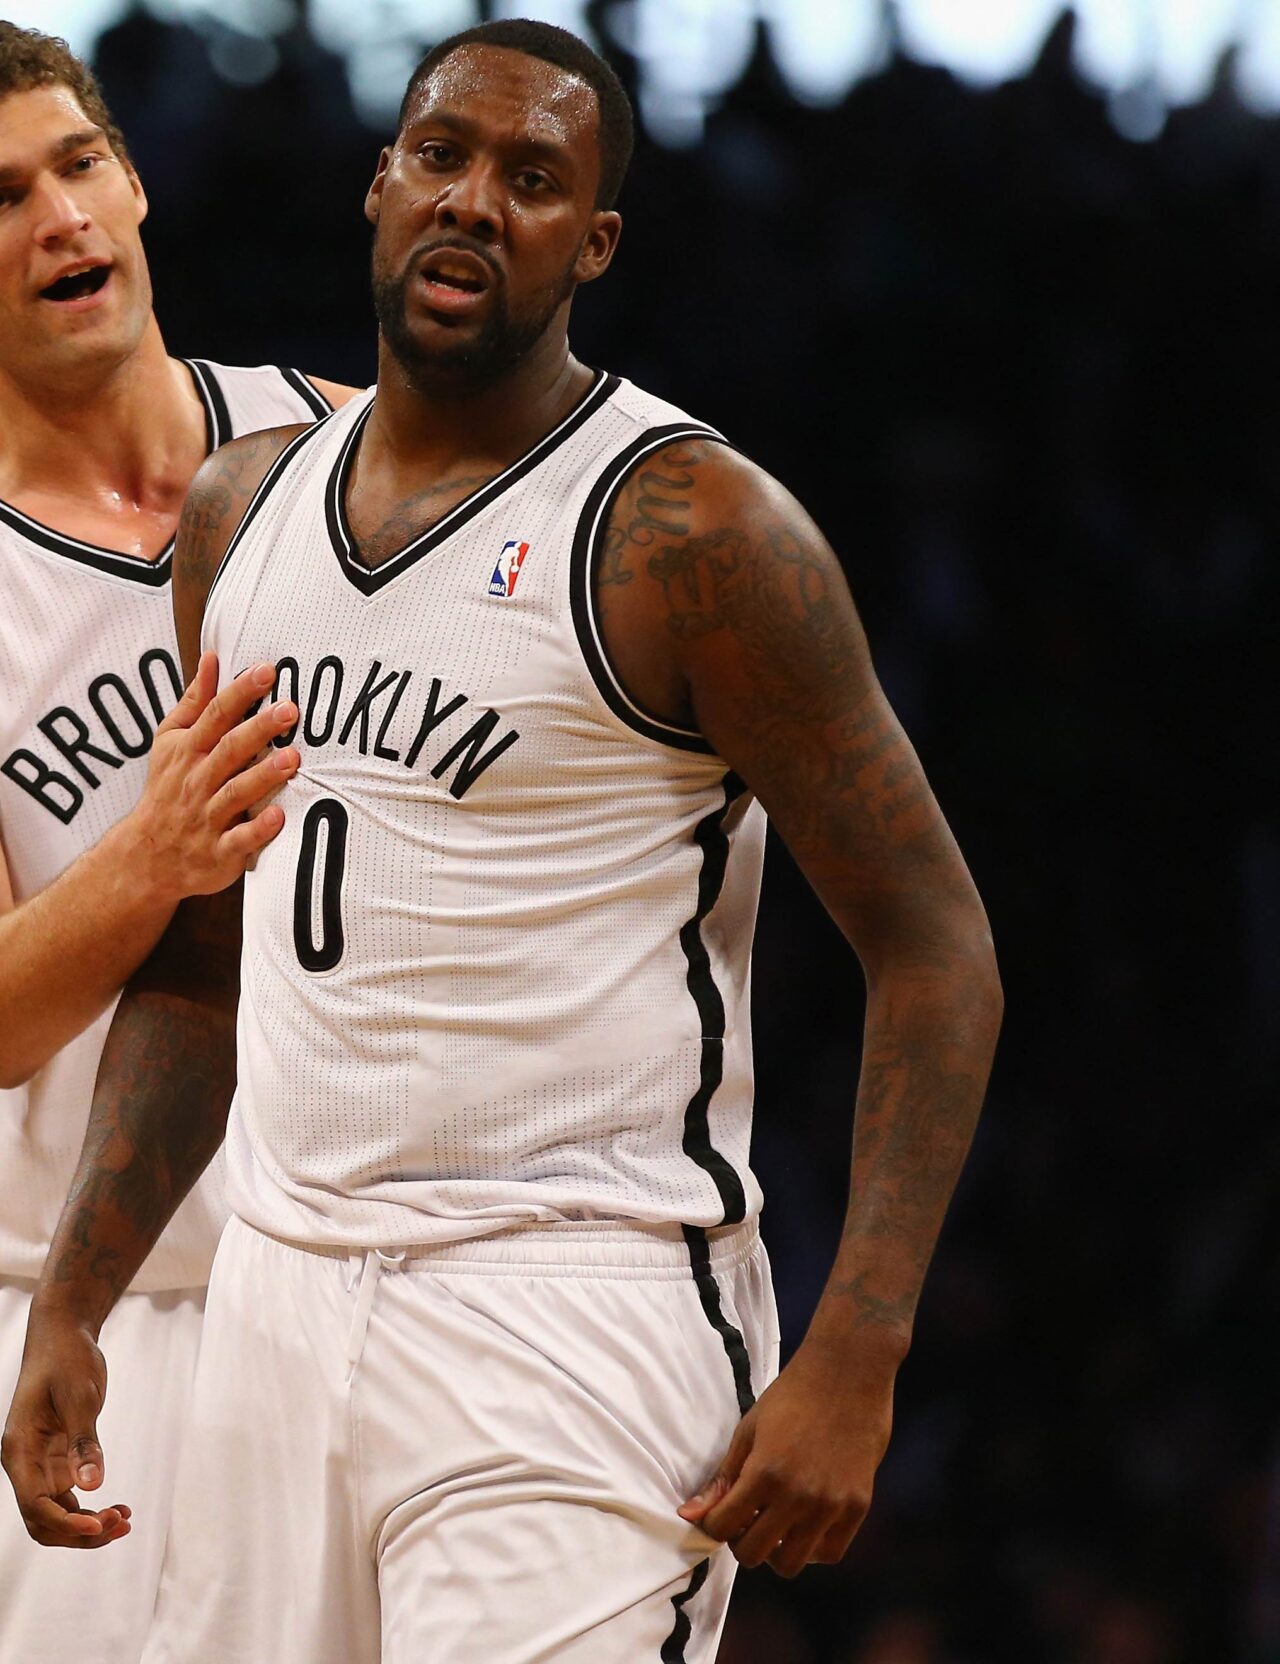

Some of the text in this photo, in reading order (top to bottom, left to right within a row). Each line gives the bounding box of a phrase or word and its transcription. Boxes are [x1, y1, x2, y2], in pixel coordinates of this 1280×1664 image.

[489, 582, 506, 595] NBA
[234, 655, 520, 800] OOKLYN
[293, 798, 349, 972] 0
